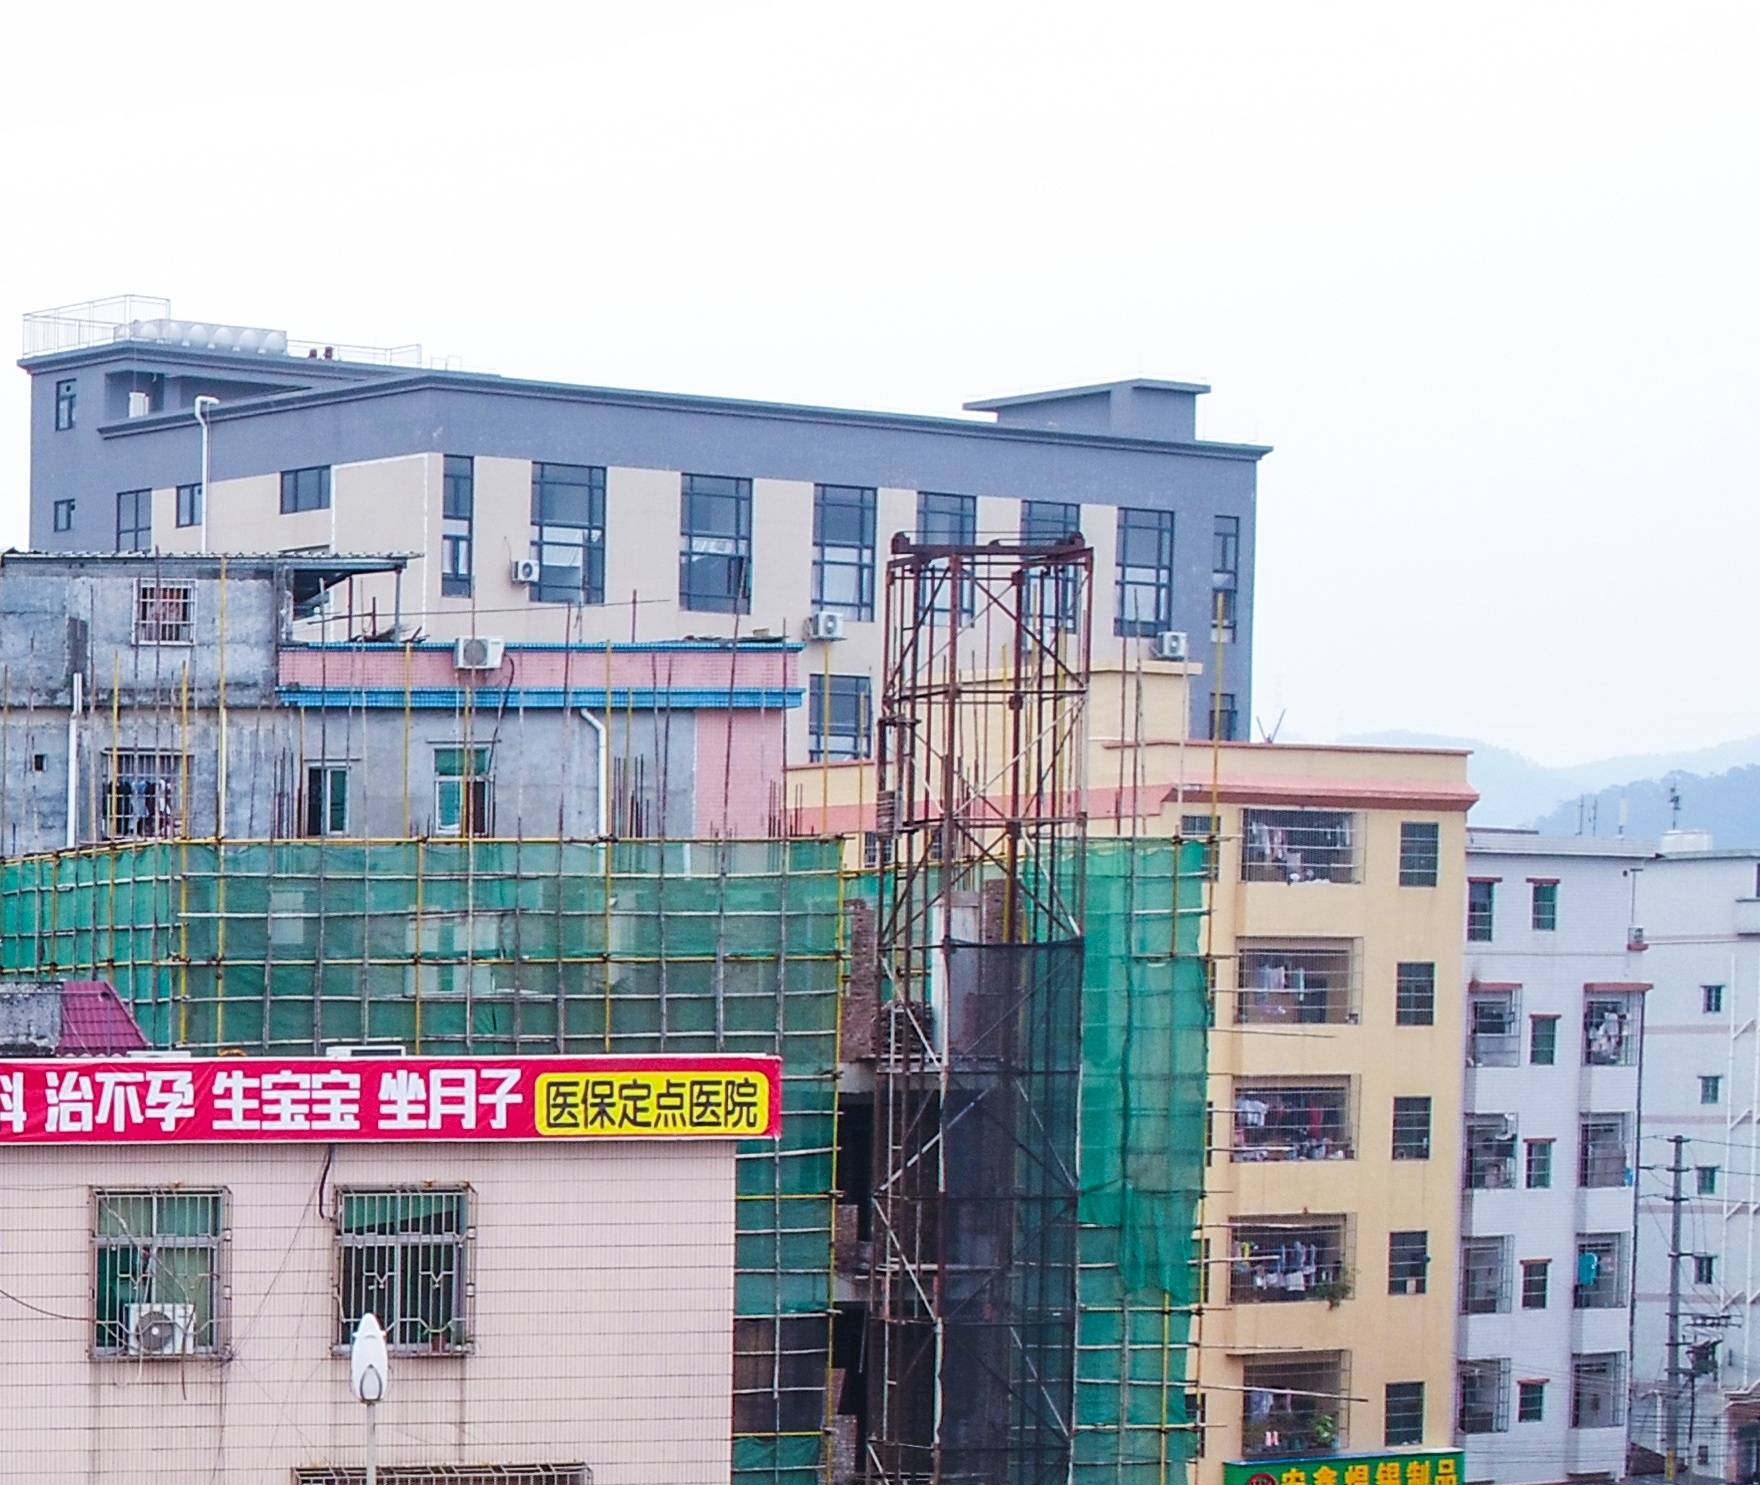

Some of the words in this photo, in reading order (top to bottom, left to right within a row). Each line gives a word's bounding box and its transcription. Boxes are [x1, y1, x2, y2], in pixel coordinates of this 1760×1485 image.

[44, 1069, 195, 1133] 治不孕
[212, 1068, 362, 1132] 生宝宝
[378, 1066, 523, 1131] 坐月子
[543, 1077, 761, 1131] 医保定点医院
